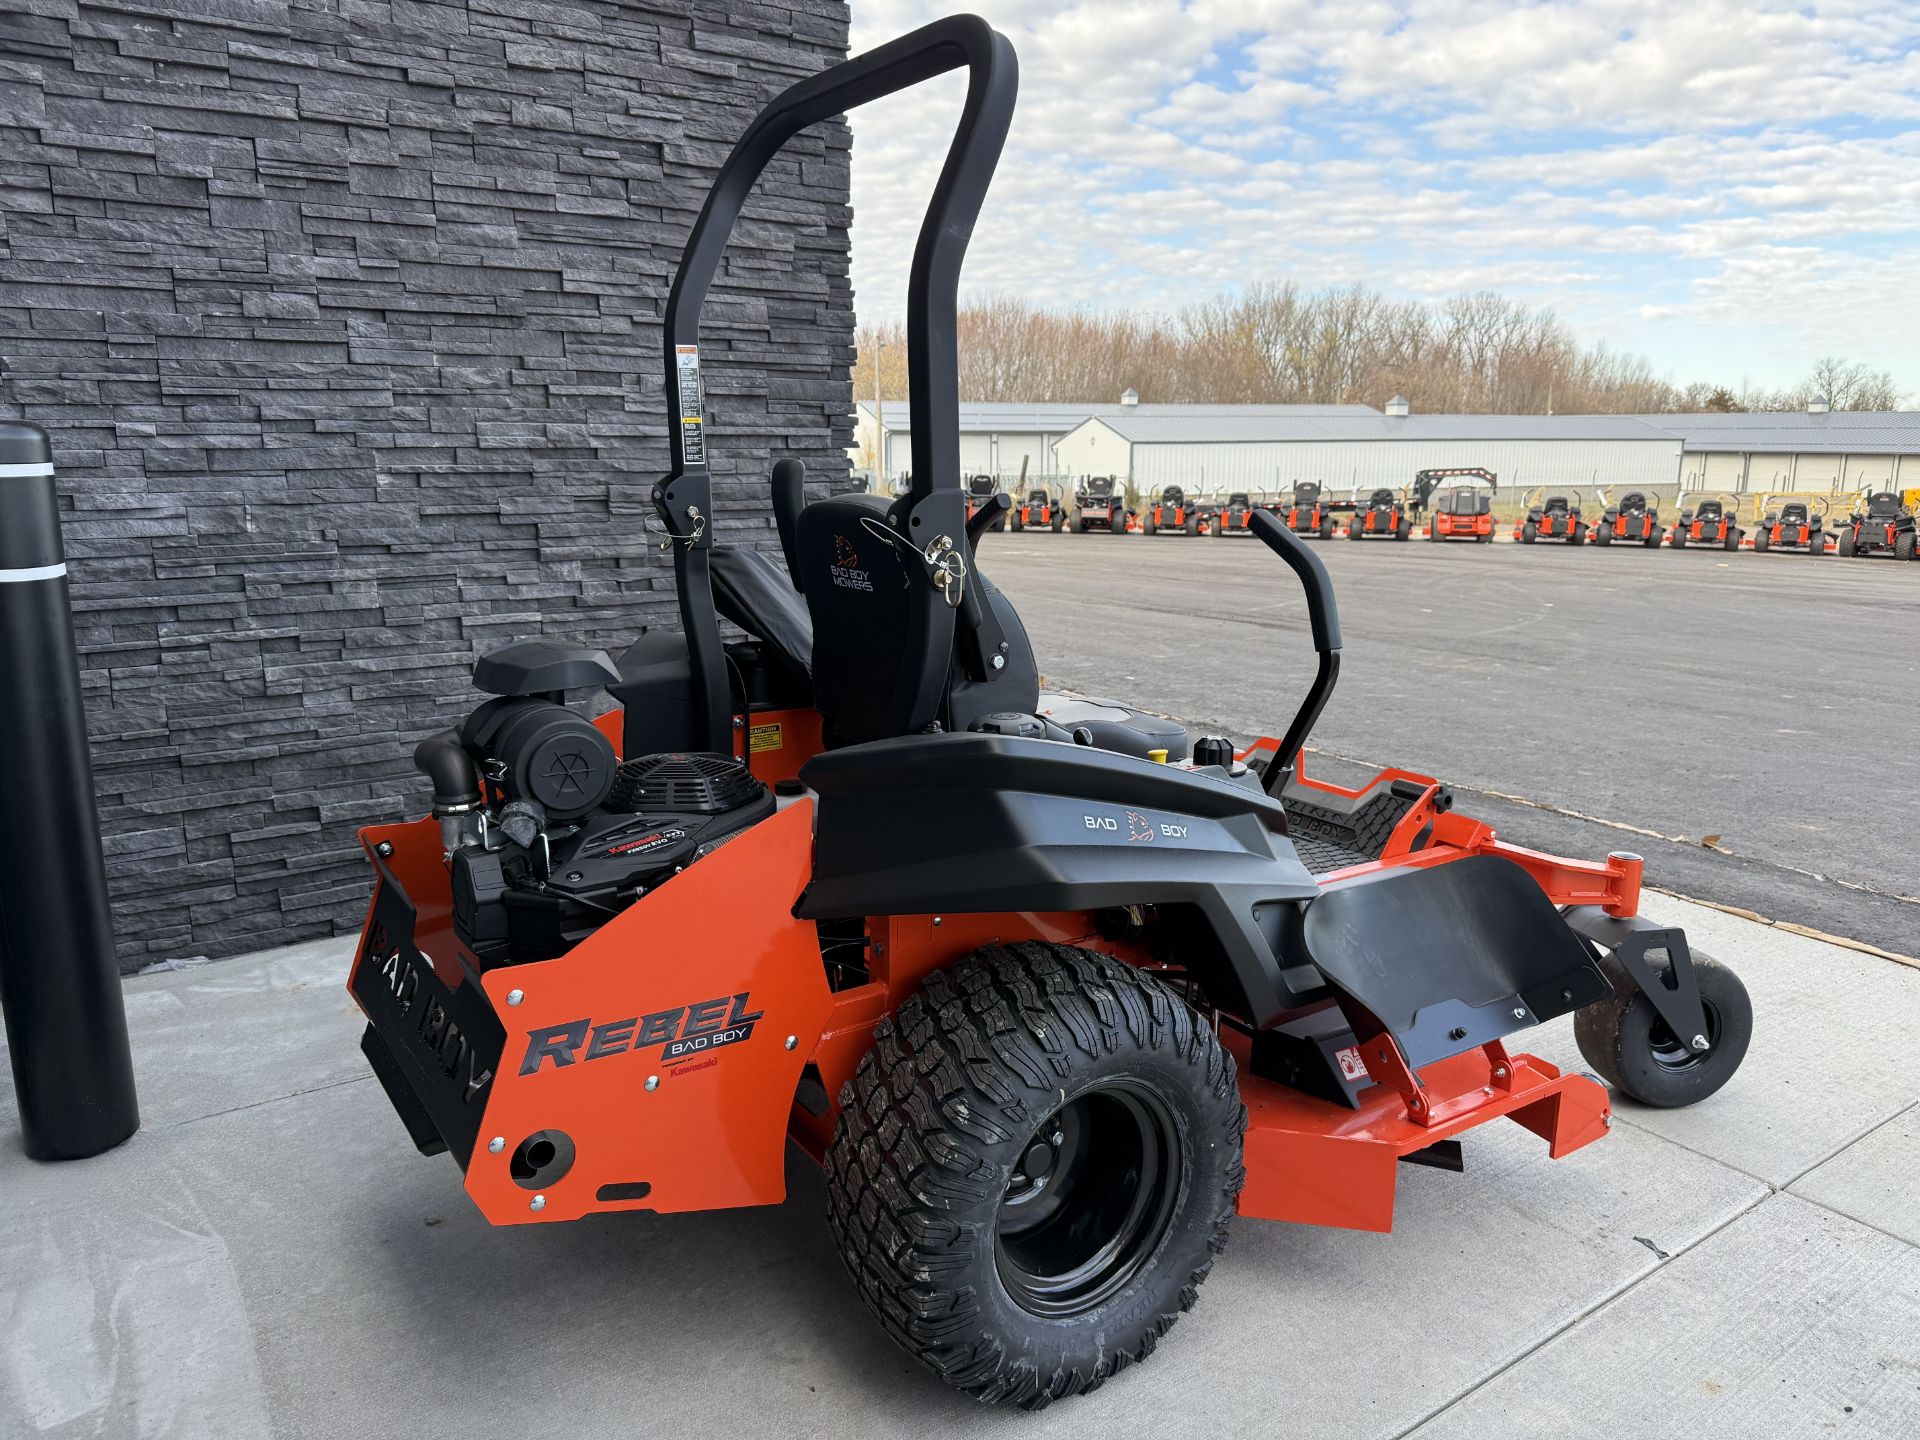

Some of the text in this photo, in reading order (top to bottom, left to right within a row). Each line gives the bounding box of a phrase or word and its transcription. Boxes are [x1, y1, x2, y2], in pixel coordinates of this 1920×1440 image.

[830, 565, 869, 581] BAD BOY
[833, 576, 873, 592] MOWERS
[750, 726, 777, 734] CAUTION
[1084, 815, 1188, 838] BAD BOY
[518, 991, 765, 1077] REBEL
[671, 1027, 747, 1055] BAD BOY
[670, 1057, 718, 1077] Kawasaki
